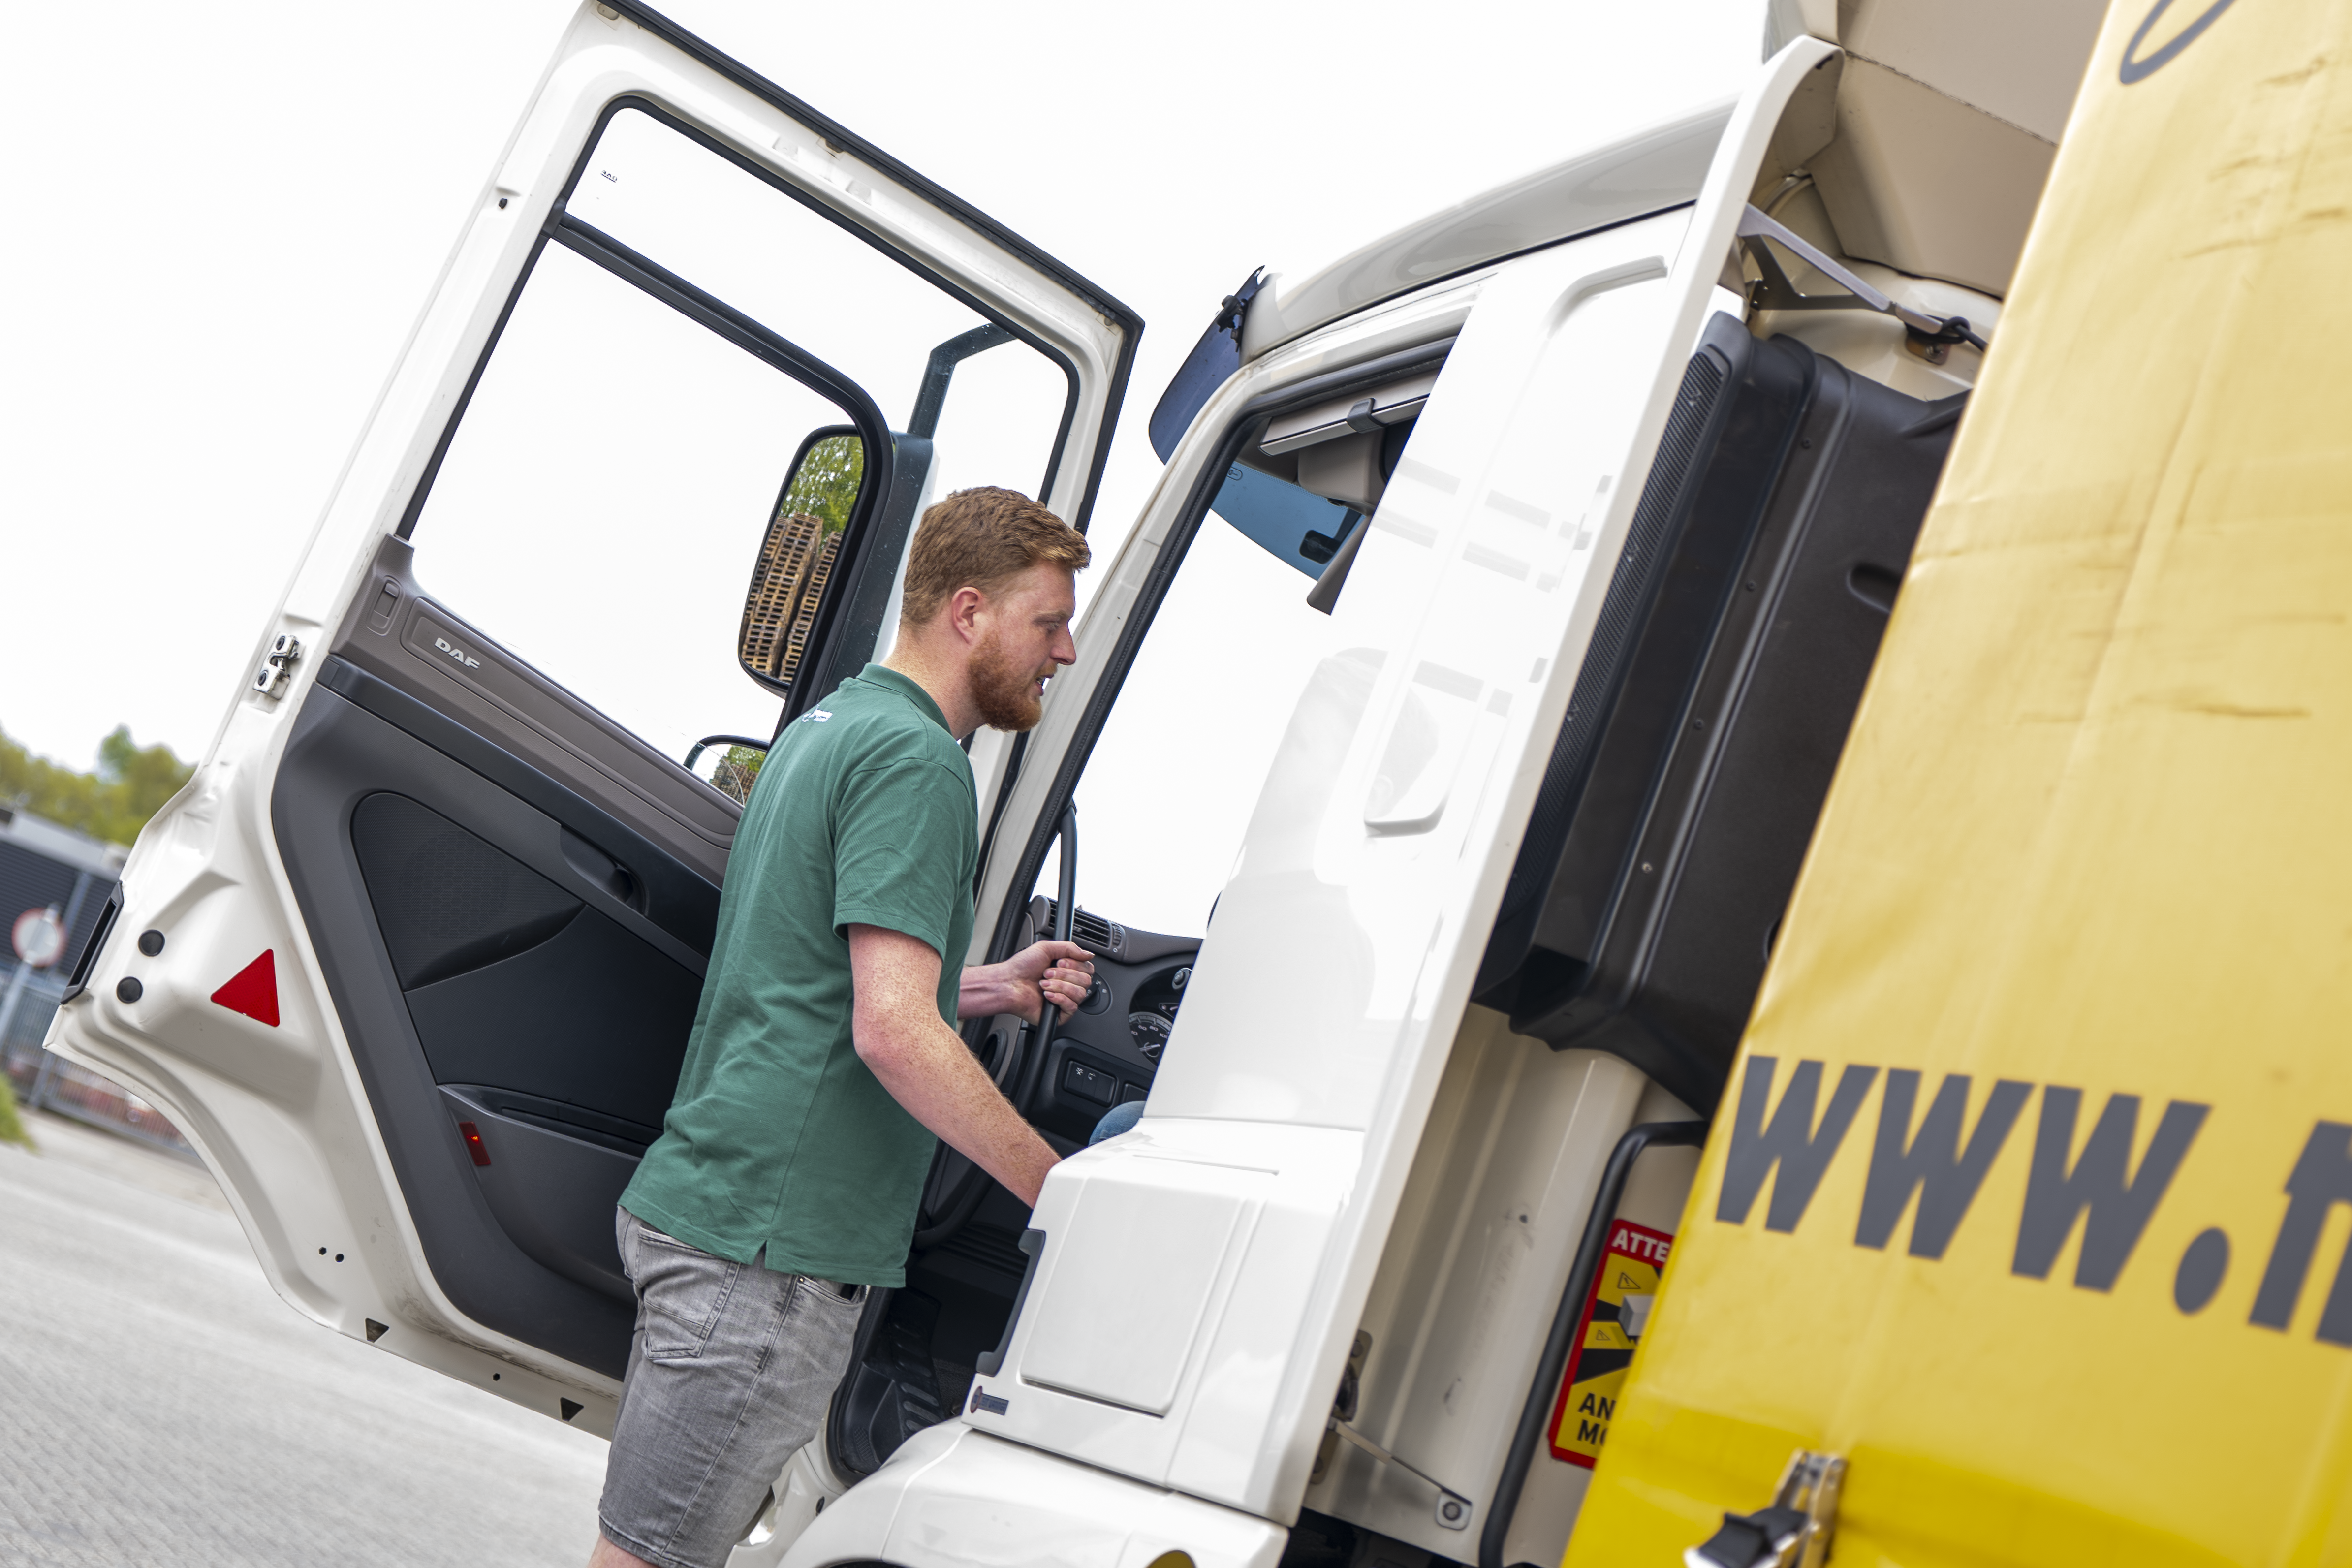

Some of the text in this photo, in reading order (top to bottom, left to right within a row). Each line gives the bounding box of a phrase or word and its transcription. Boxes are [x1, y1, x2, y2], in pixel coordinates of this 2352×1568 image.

[434, 637, 480, 669] DAF
[1611, 1228, 1670, 1263] ATTE
[1578, 1392, 1617, 1421] AN
